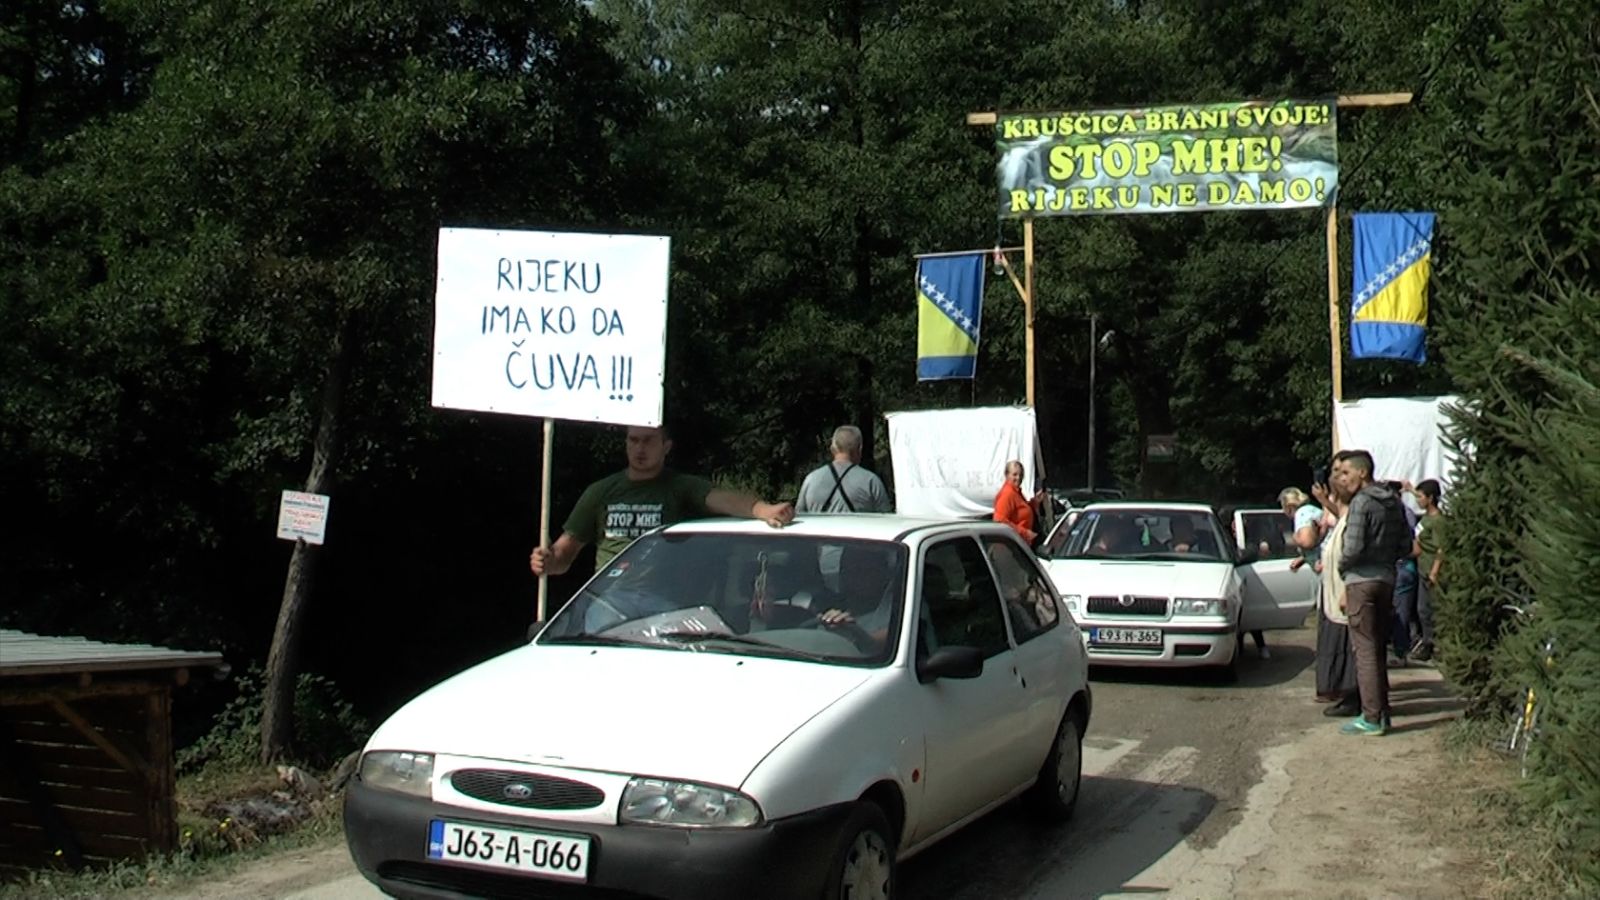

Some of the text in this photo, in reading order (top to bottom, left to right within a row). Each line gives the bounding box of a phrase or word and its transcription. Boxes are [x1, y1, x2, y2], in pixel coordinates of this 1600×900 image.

[1003, 105, 1329, 138] KRUŠČICA BRANI SVOJE!
[1048, 136, 1282, 180] STOP MHE!
[1010, 178, 1326, 212] RIJEKU NE DAMO!
[497, 257, 601, 294] RIJEKU
[481, 305, 624, 336] IMA KO DA
[606, 512, 634, 527] STOP
[447, 827, 582, 872] J63-A-066
